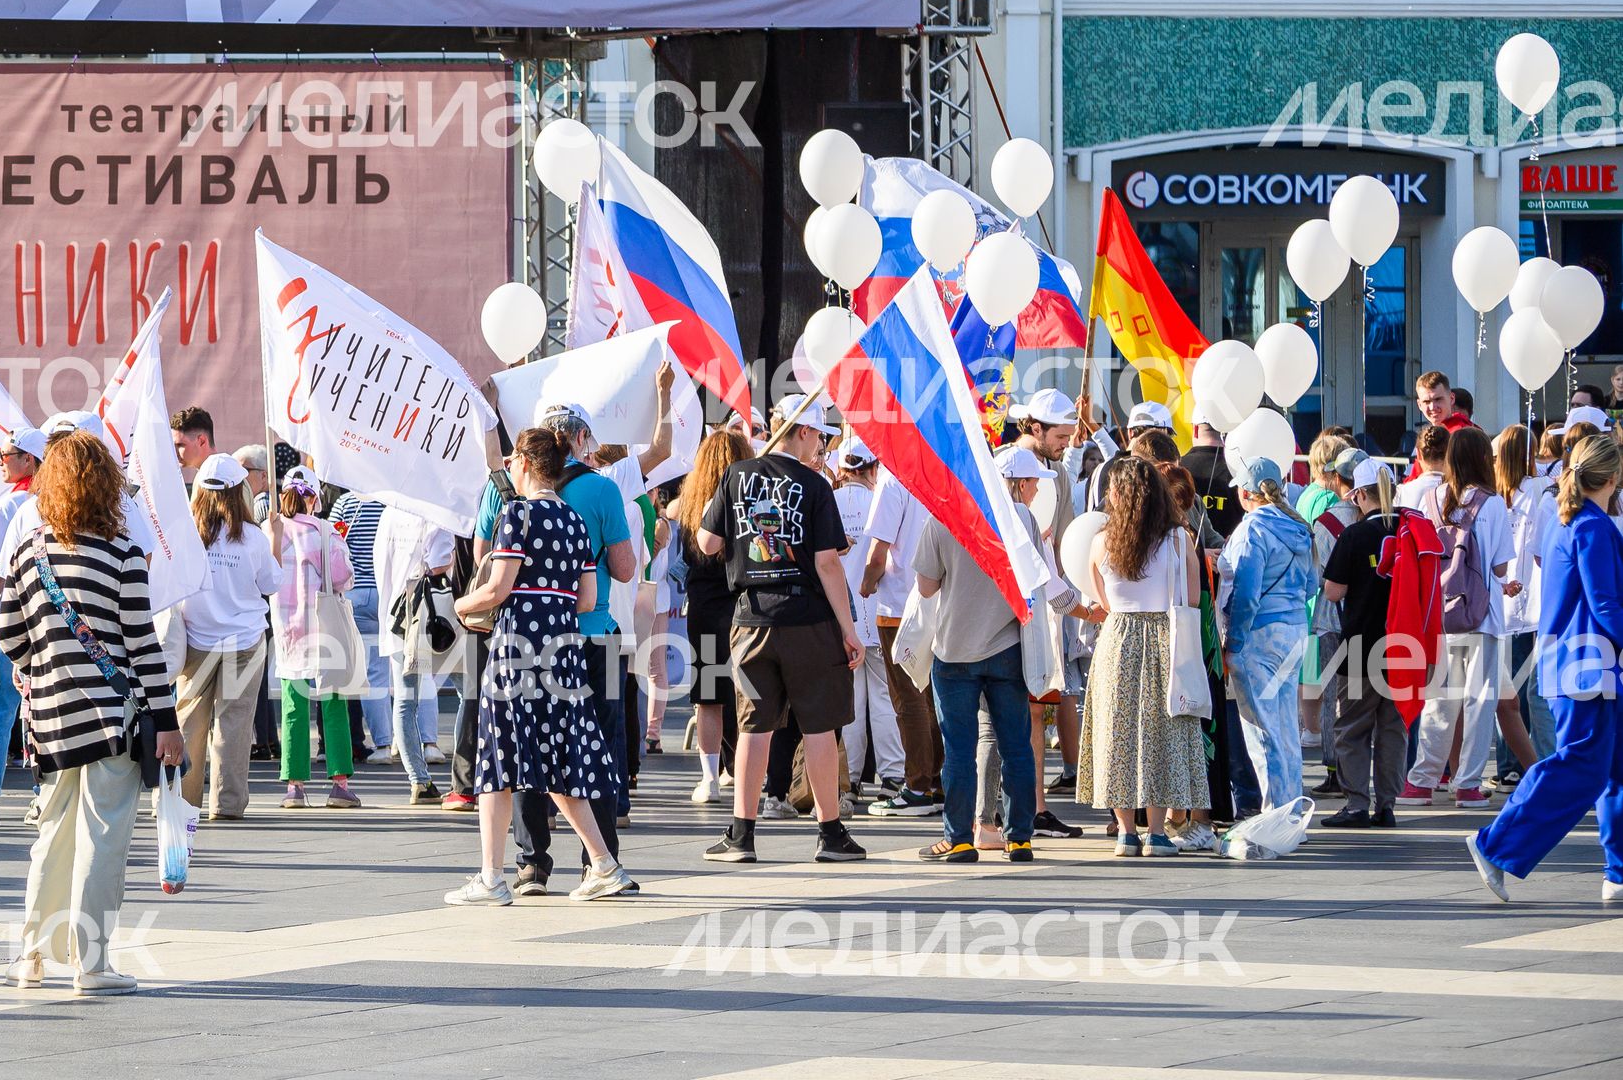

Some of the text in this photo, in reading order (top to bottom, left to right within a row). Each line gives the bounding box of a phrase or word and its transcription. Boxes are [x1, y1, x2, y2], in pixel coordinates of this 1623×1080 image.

[1163, 173, 1428, 205] СОВКОМБНК
[1522, 165, 1618, 193] ВАШЕ
[321, 323, 470, 419] УЧИТЕЛЬ
[308, 363, 465, 461] УЧЕНИКИ
[339, 438, 362, 453] 2024
